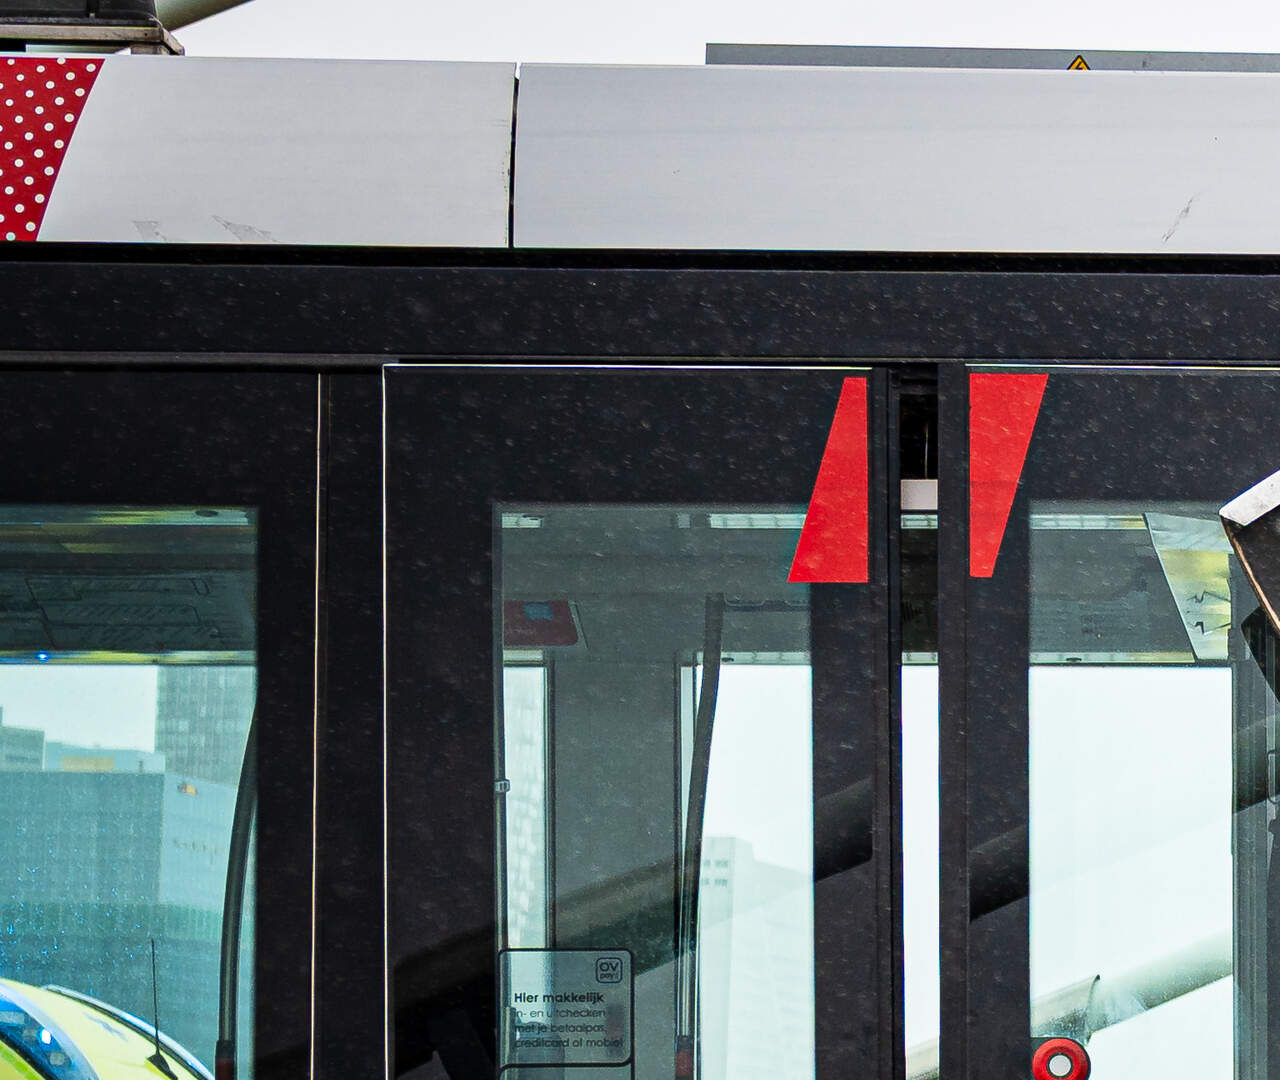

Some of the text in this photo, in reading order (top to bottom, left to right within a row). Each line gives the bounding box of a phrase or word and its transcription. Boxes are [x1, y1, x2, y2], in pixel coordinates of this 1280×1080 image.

[600, 962, 619, 972] OV
[514, 992, 605, 1004] Hier makkelijk
[529, 1010, 544, 1018] en
[546, 1008, 606, 1018] utchecken
[514, 1023, 536, 1033] met
[536, 1023, 548, 1034] je
[572, 1038, 583, 1048] of
